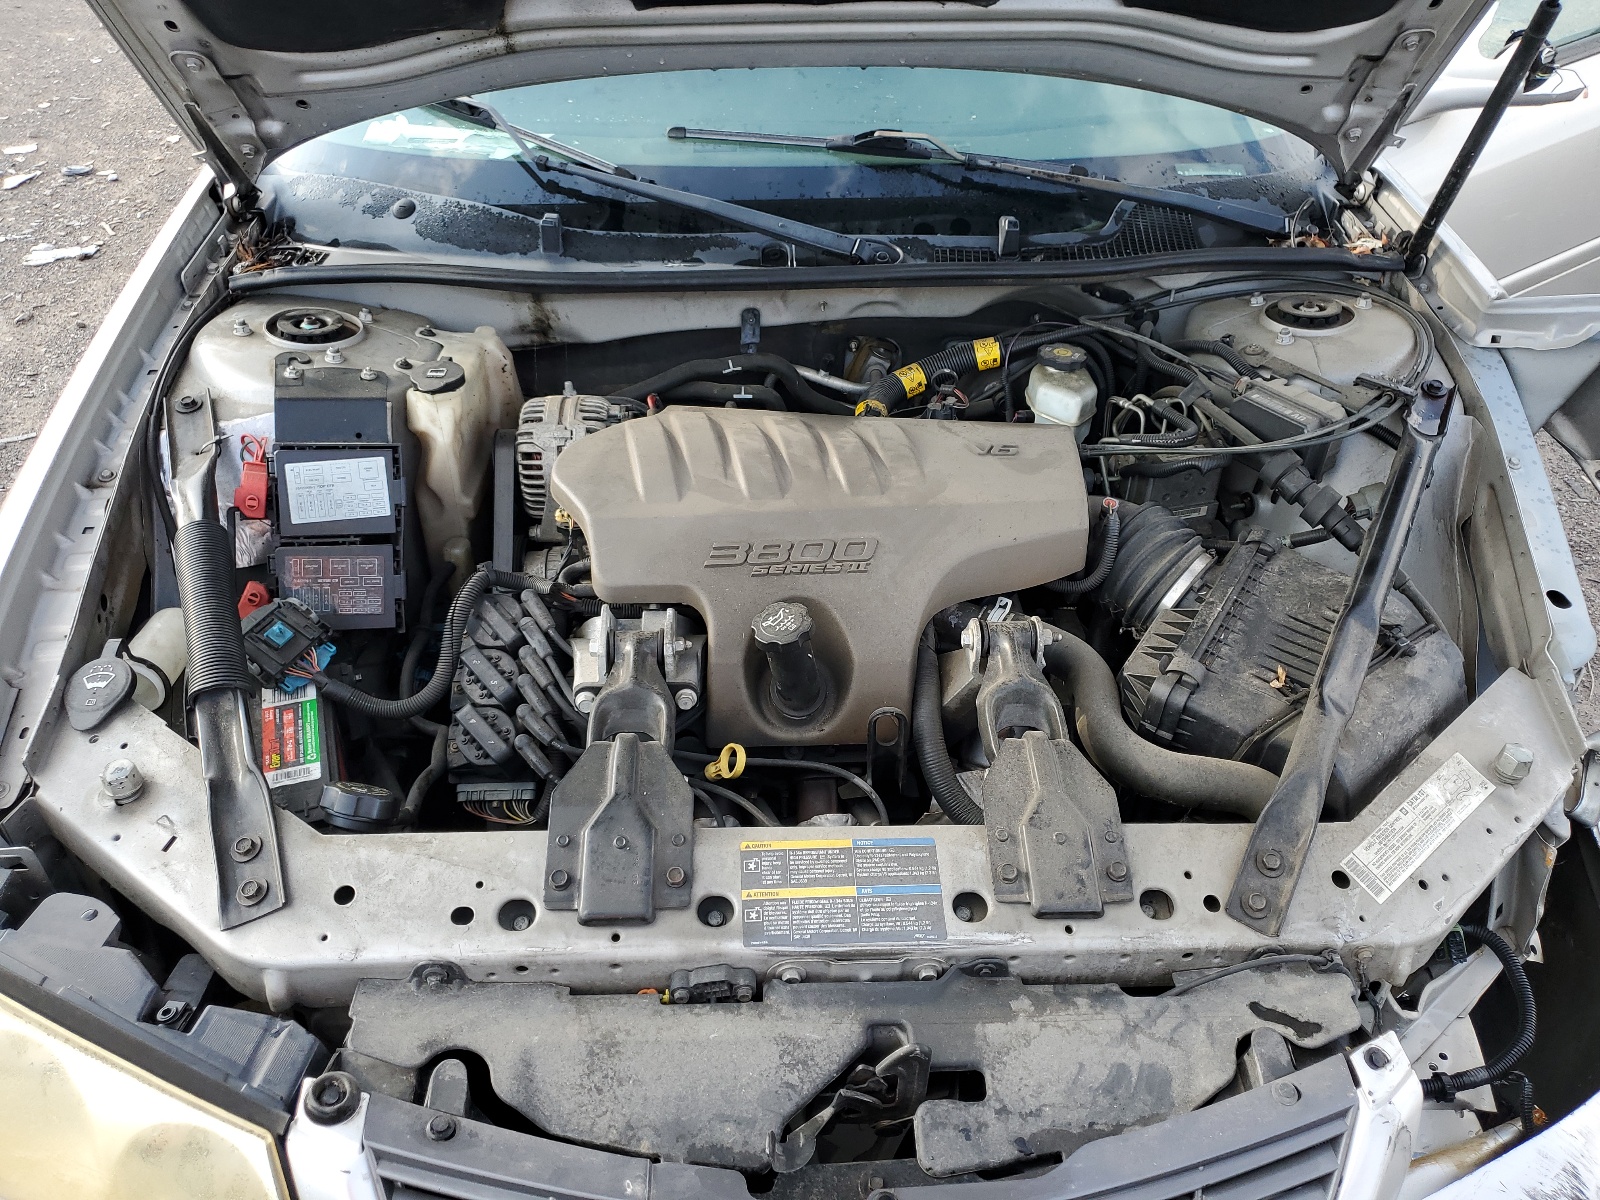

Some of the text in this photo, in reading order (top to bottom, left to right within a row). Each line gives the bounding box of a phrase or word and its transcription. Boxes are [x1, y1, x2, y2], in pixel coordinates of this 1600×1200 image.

[970, 444, 1019, 456] V6
[704, 537, 879, 568] 3800
[751, 562, 871, 577] SERIES II
